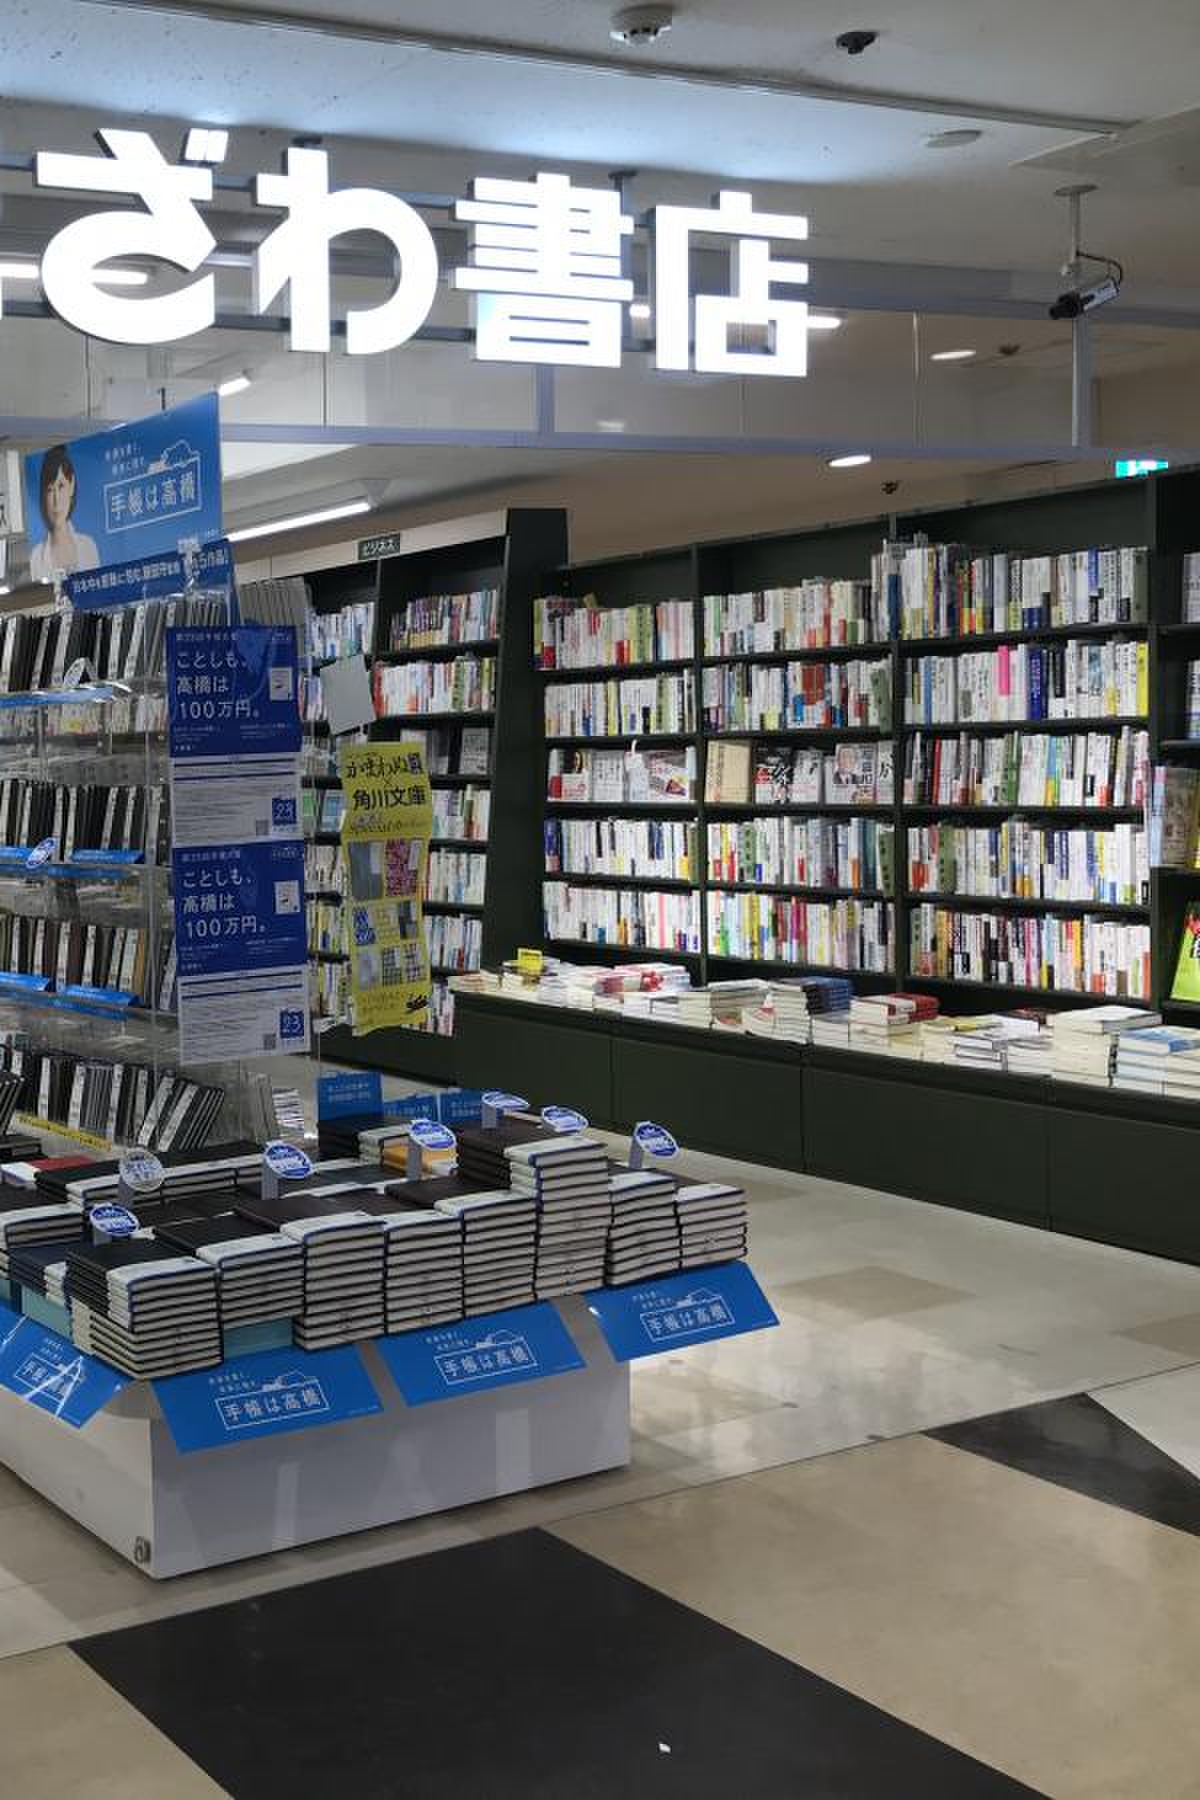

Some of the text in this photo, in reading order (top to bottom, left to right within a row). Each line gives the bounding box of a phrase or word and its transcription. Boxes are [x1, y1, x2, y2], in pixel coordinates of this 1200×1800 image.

[179, 699, 260, 719] 100万円。
[352, 784, 426, 811] 角川文庫
[186, 914, 265, 939] 100万円。
